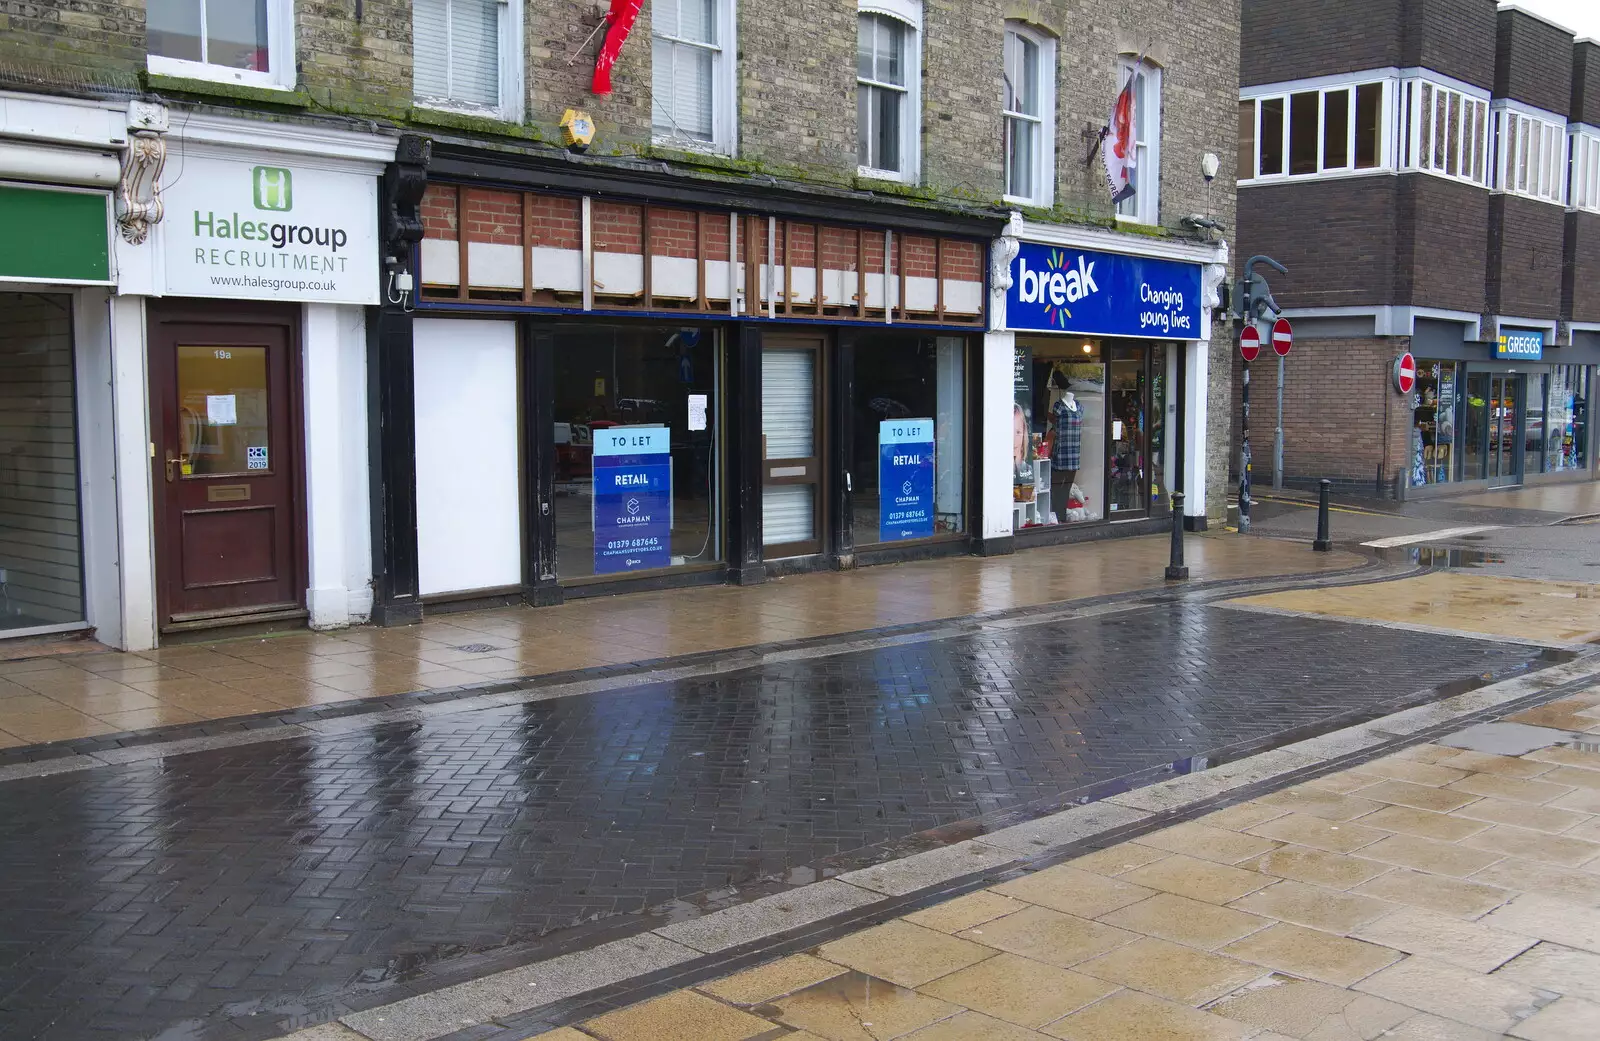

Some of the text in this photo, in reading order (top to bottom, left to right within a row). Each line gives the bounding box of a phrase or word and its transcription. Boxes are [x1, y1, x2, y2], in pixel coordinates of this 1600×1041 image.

[194, 210, 347, 252] Halesgroup
[195, 247, 348, 272] RECRUITMENT
[210, 275, 336, 291] www.halesgroup.co.uk
[1019, 254, 1099, 306] break
[1140, 282, 1183, 312] Changing
[1140, 310, 1190, 334] young lives
[1507, 335, 1540, 354] GREGGS
[213, 350, 232, 359] 19a
[892, 427, 921, 437] TO LET
[612, 436, 651, 447] TO LET
[249, 461, 267, 469] 2019
[893, 454, 921, 466] RETAIL
[615, 473, 649, 485] RETAIL
[895, 495, 920, 503] CHAPMAN
[616, 515, 651, 524] CHAPMAN
[607, 537, 658, 549] 01379 687645
